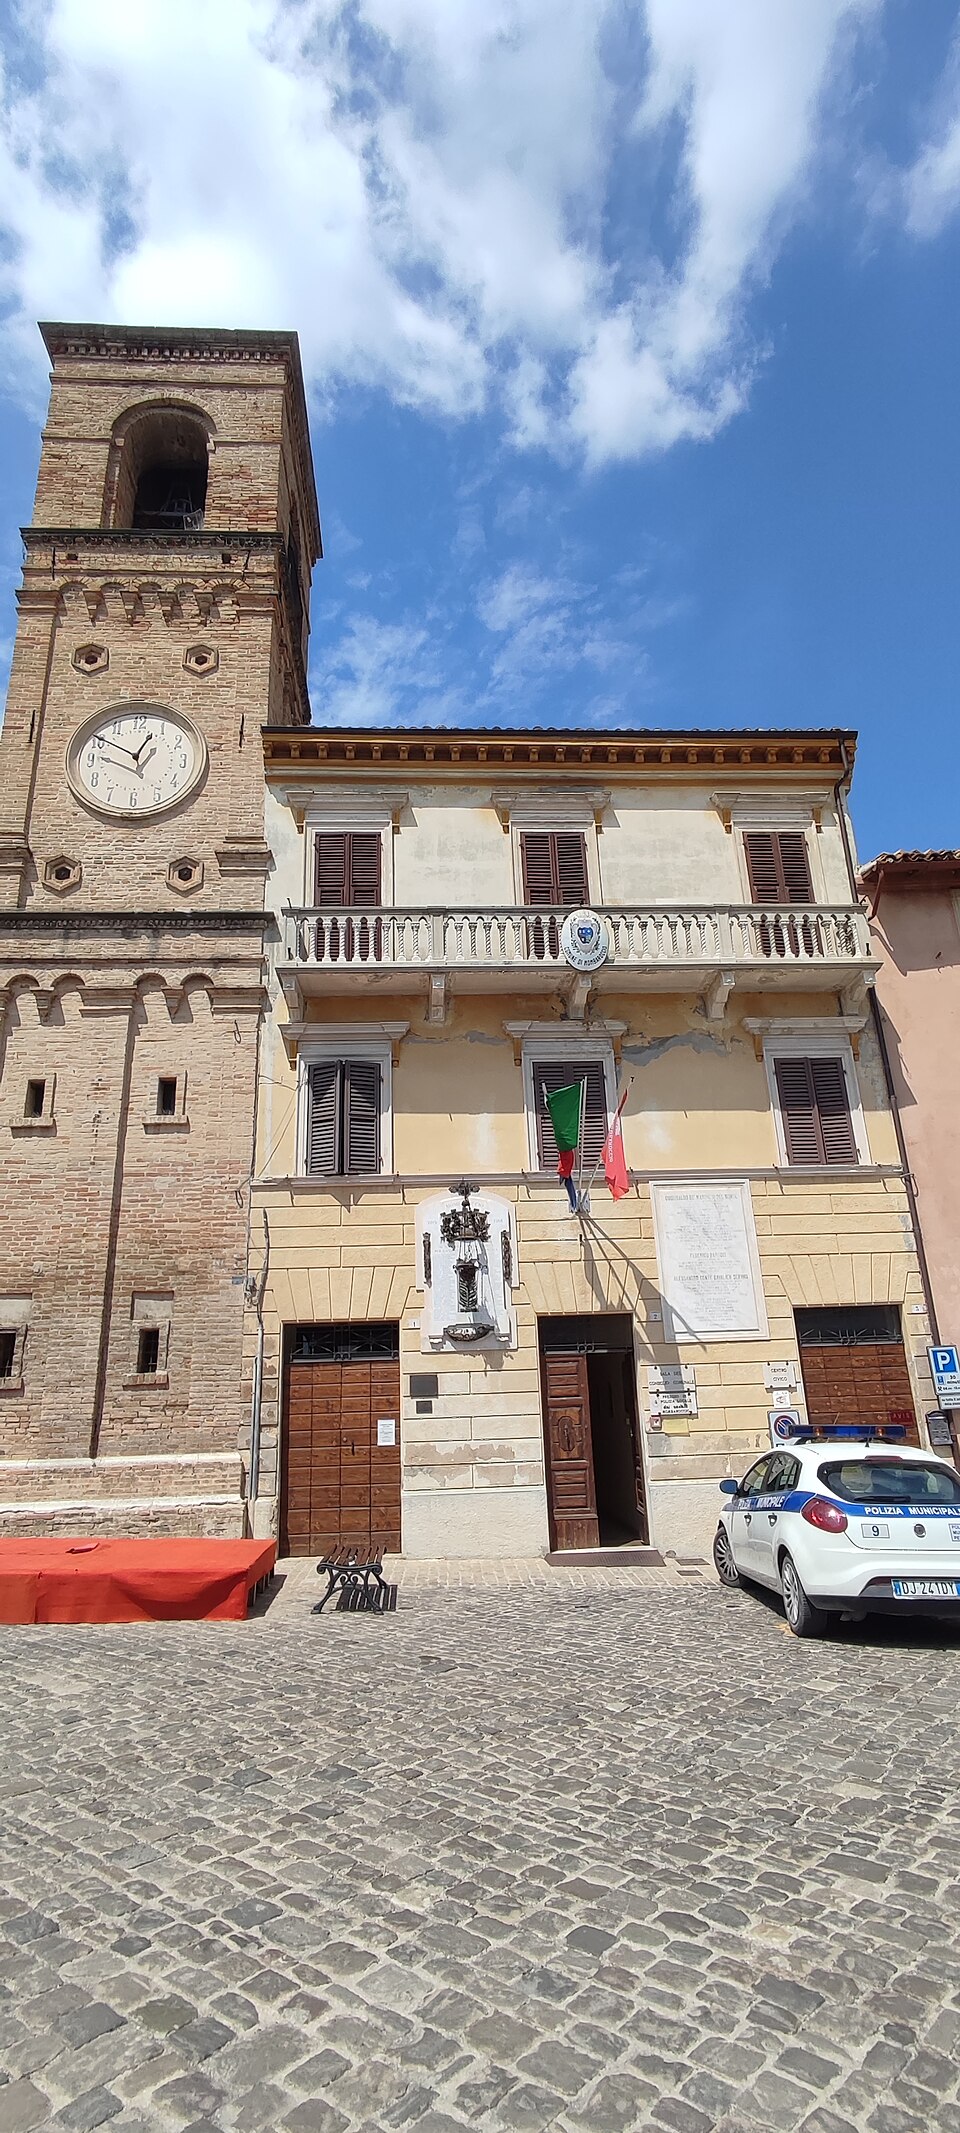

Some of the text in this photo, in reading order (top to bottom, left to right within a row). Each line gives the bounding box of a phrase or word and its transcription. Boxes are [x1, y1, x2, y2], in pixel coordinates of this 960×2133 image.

[112, 720, 122, 735] 11
[133, 715, 147, 730] 12
[160, 721, 166, 735] 1
[174, 735, 183, 750] 2
[86, 752, 95, 768] 9
[180, 753, 187, 769] 3
[91, 772, 99, 787] 8
[170, 773, 180, 788] 4
[107, 787, 115, 802] 7
[130, 791, 138, 808] 6
[153, 787, 161, 802] 5
[936, 1352, 951, 1371] P
[864, 1506, 904, 1515] POLIZIA
[871, 1525, 880, 1537] 9
[901, 1582, 918, 1595] DJ
